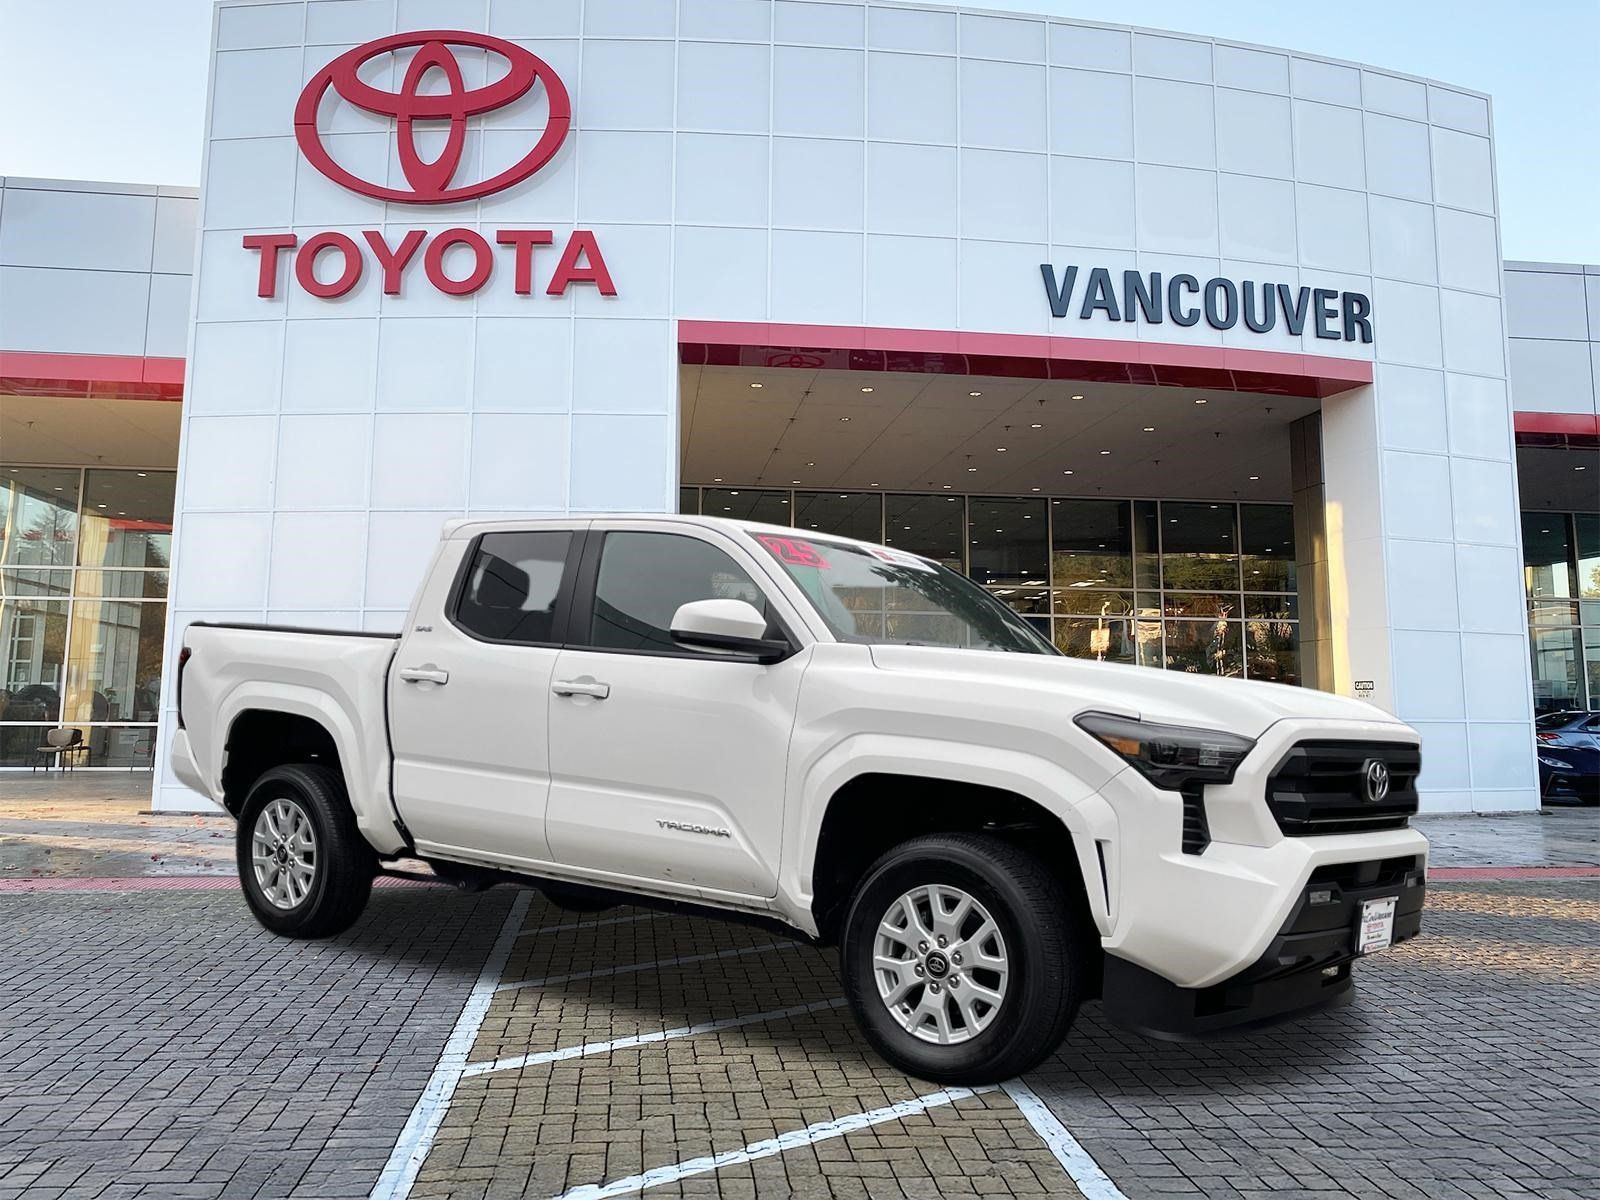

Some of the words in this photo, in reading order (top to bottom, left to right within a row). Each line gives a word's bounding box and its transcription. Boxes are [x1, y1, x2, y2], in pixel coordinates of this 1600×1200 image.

[243, 227, 617, 299] TOYOTA
[1040, 263, 1373, 344] VANCOUVER
[656, 819, 731, 838] TACOMA
